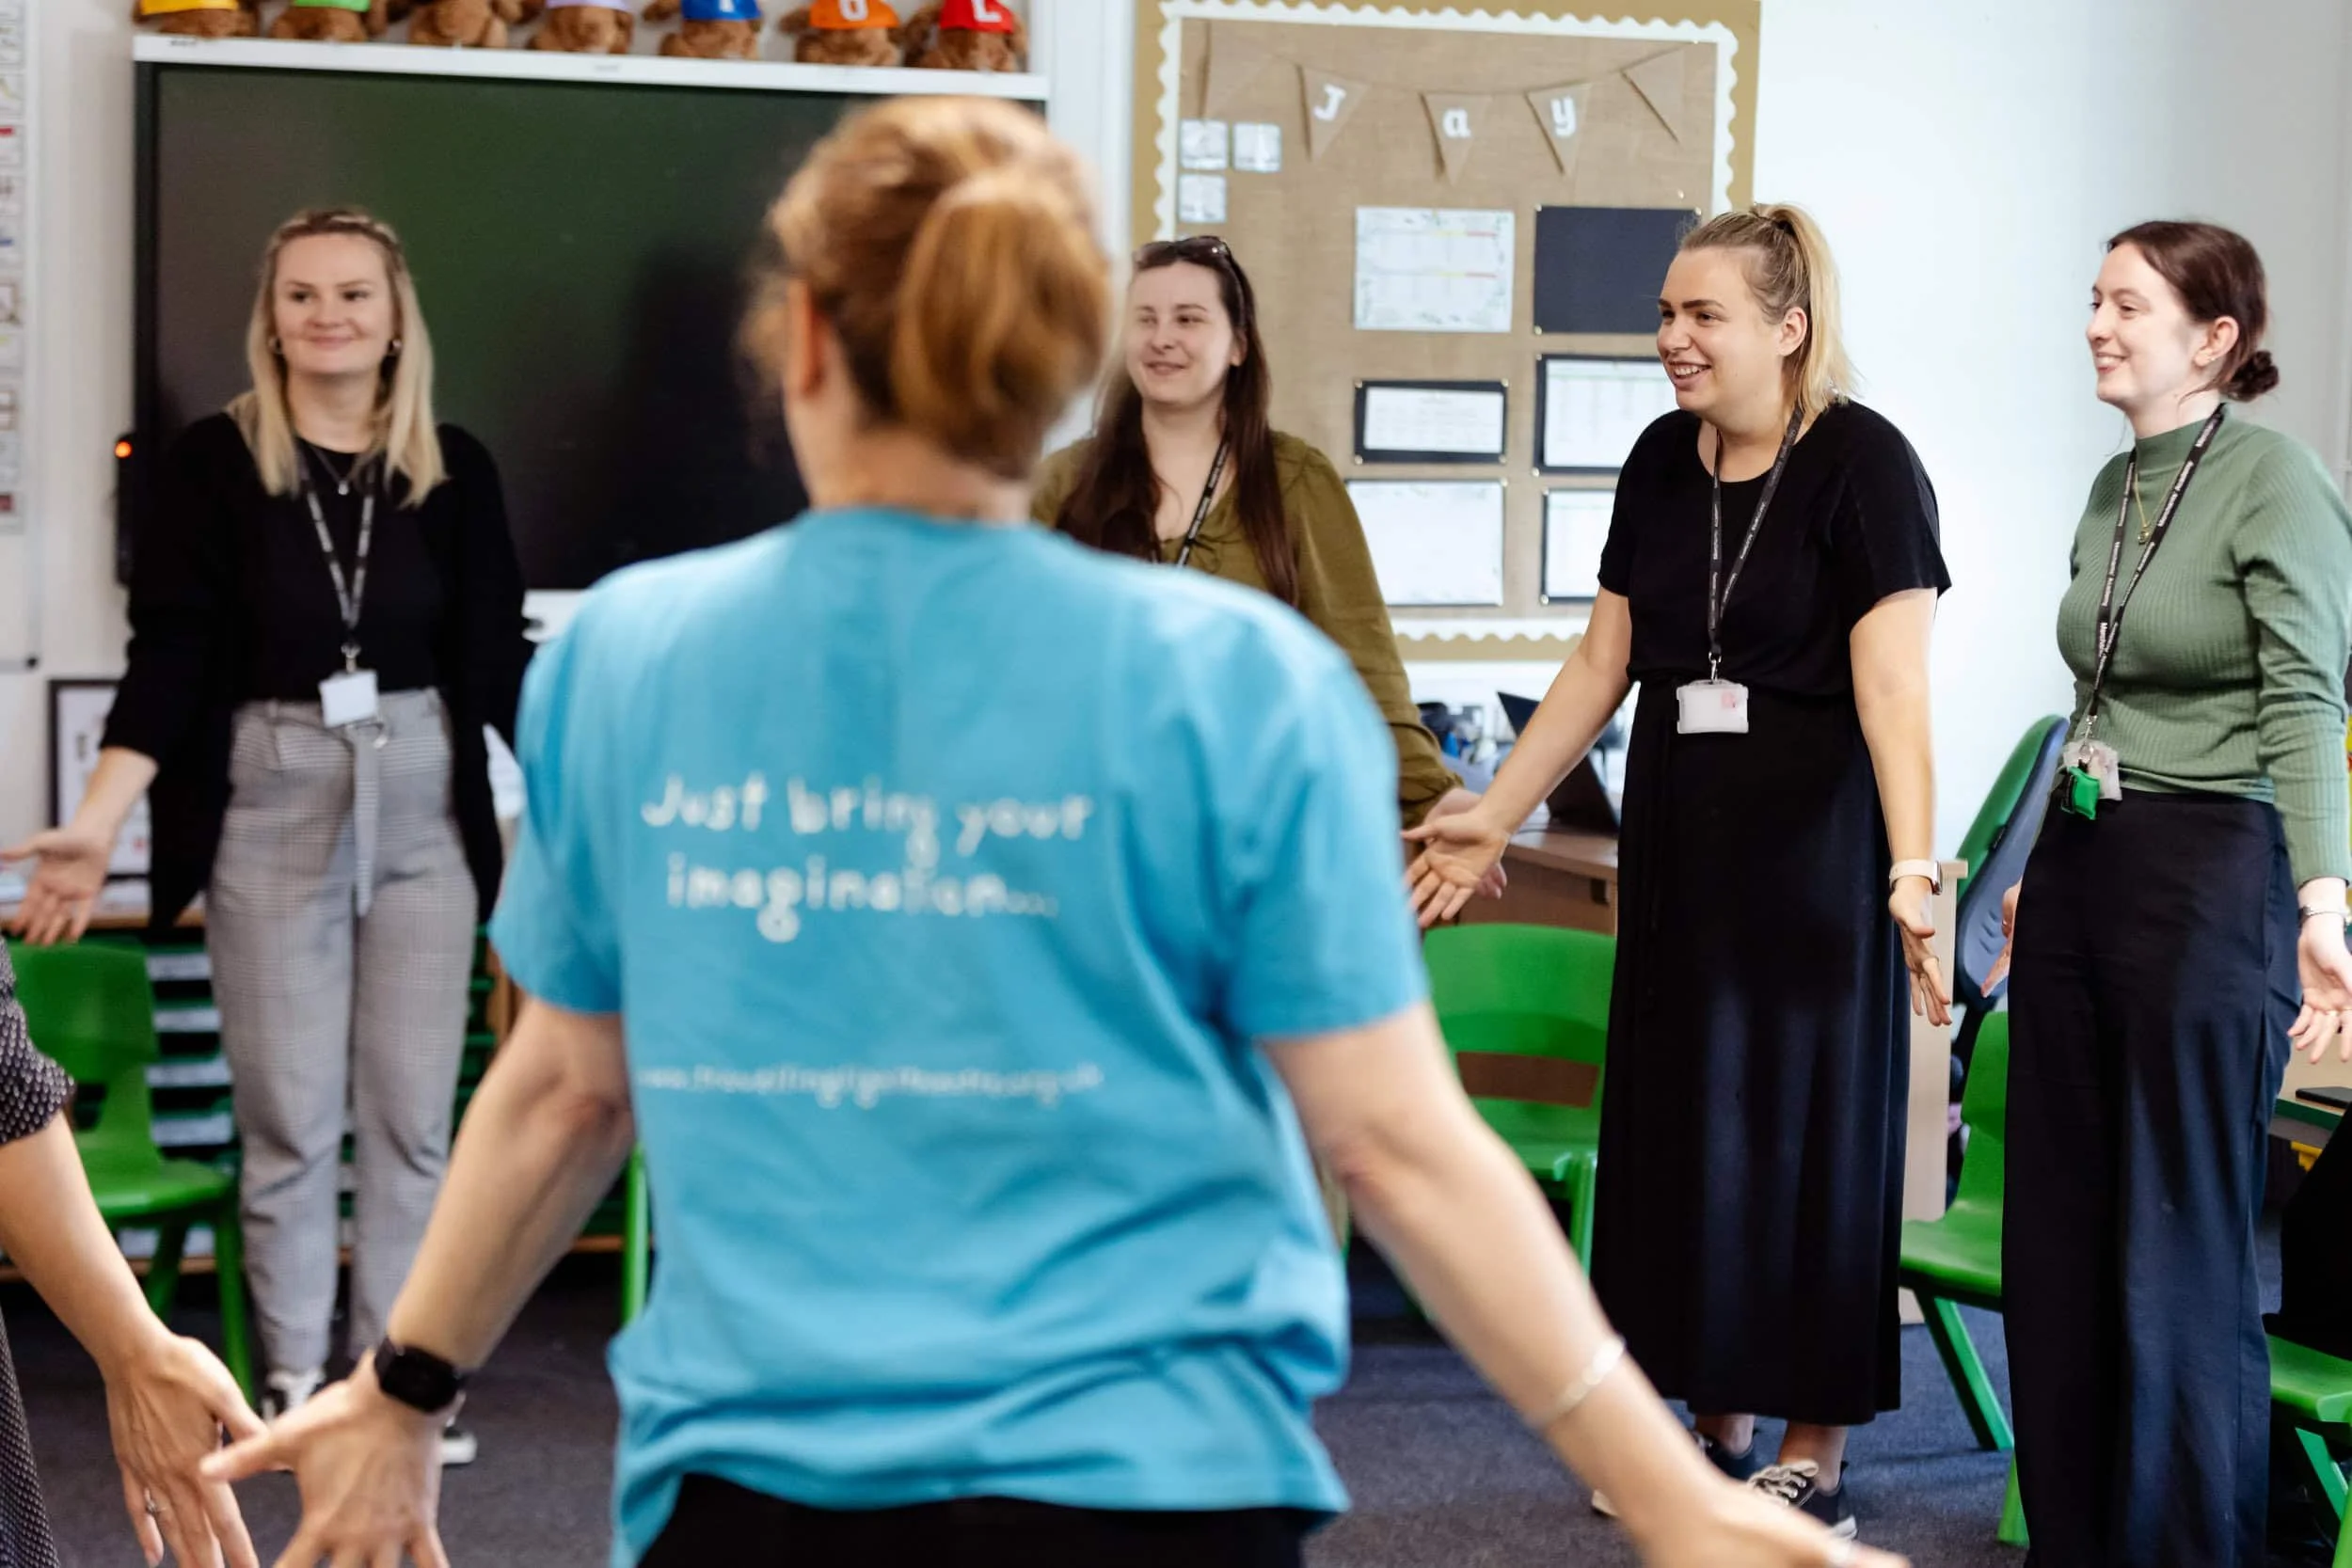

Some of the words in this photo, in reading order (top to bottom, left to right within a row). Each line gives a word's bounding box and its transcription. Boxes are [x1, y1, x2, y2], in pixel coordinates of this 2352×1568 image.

[641, 769, 769, 832] Just
[787, 774, 939, 870] bring
[955, 793, 1094, 858] your
